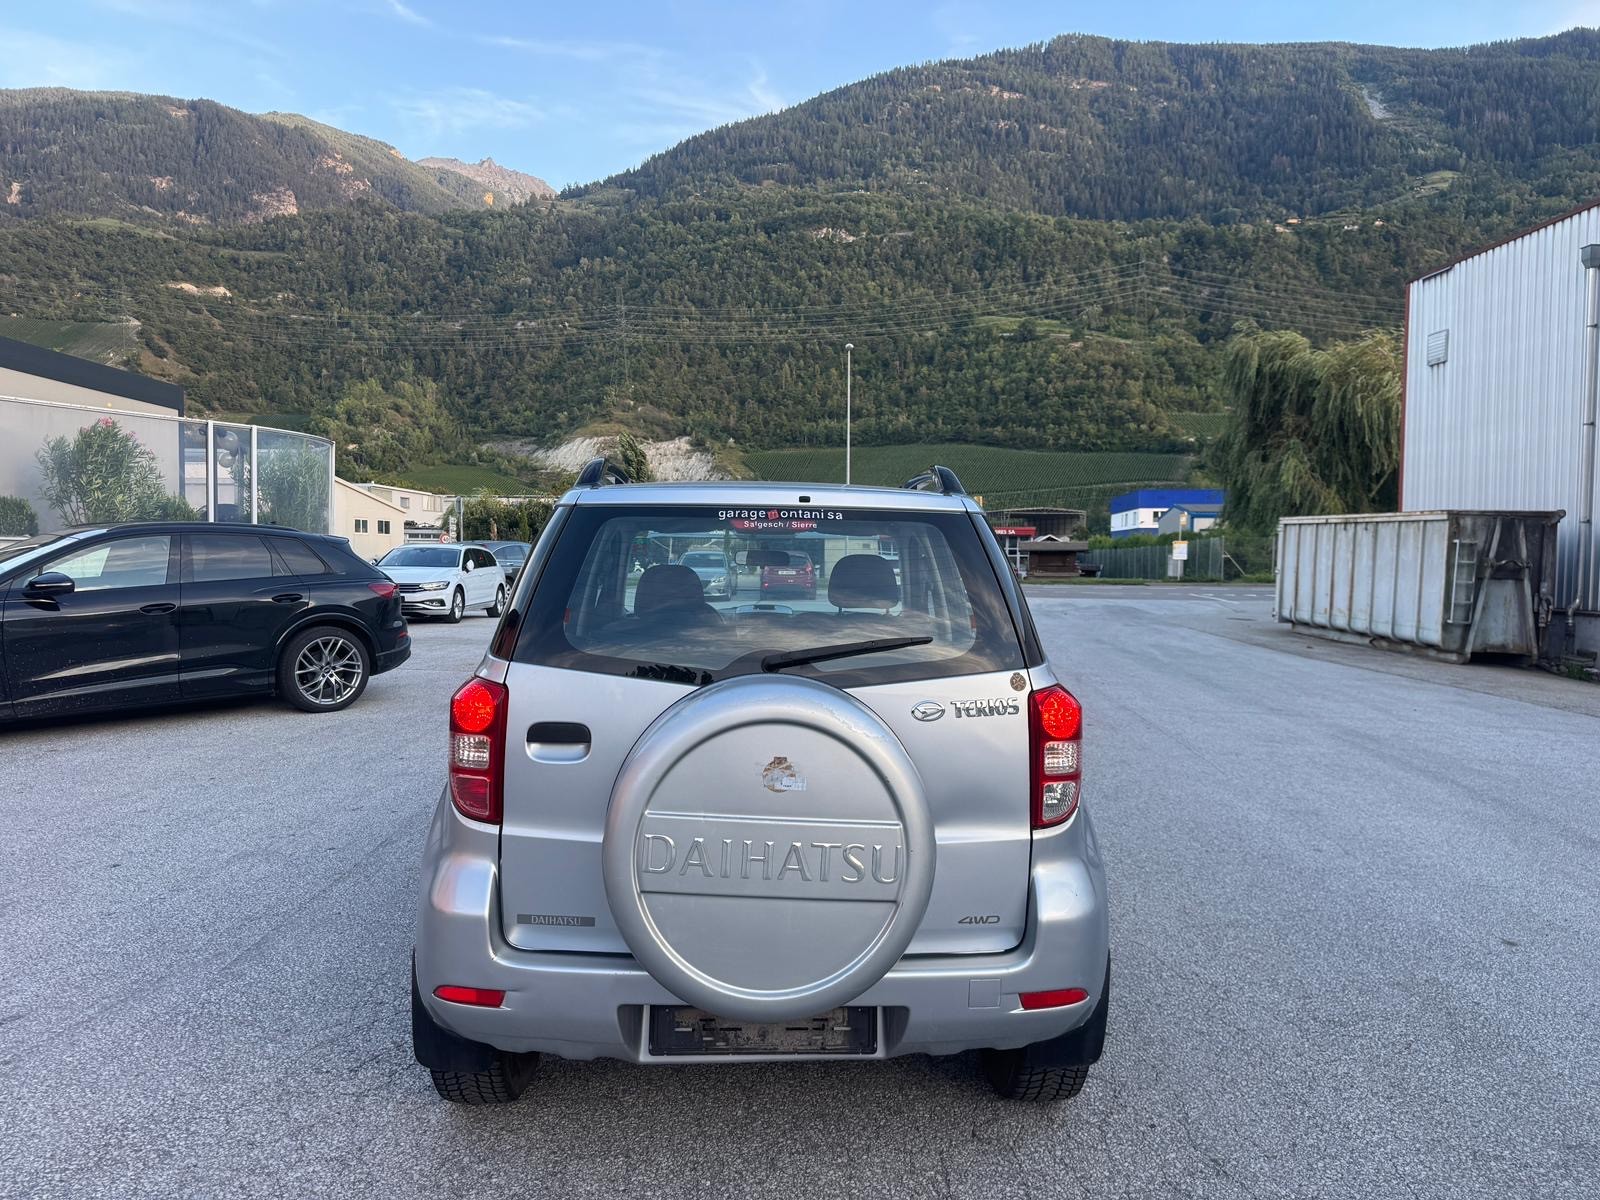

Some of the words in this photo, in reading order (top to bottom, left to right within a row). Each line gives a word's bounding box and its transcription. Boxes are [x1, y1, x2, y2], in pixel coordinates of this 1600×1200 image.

[718, 509, 766, 520] garage
[827, 511, 843, 520] sa
[791, 521, 818, 529] Sierre
[950, 697, 1020, 719] TERIOS
[640, 833, 904, 884] DAIHATSU
[531, 915, 581, 926] DAIHATSU
[957, 915, 1001, 925] 4WD
